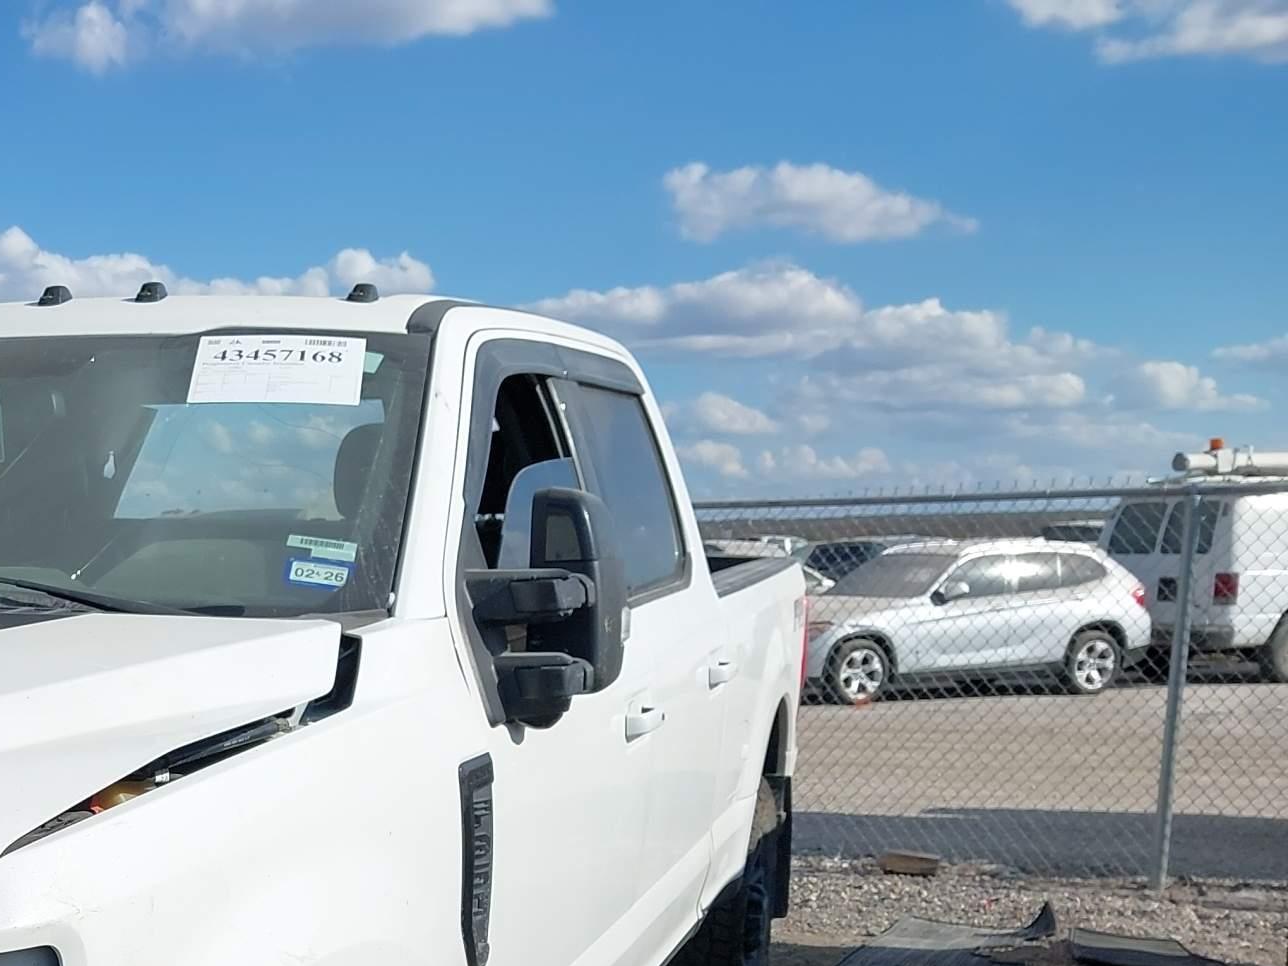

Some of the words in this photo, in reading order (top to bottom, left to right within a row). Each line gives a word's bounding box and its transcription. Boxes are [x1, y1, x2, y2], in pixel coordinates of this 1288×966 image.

[213, 349, 343, 364] 43457168
[295, 567, 315, 578] 02
[324, 571, 344, 582] 26
